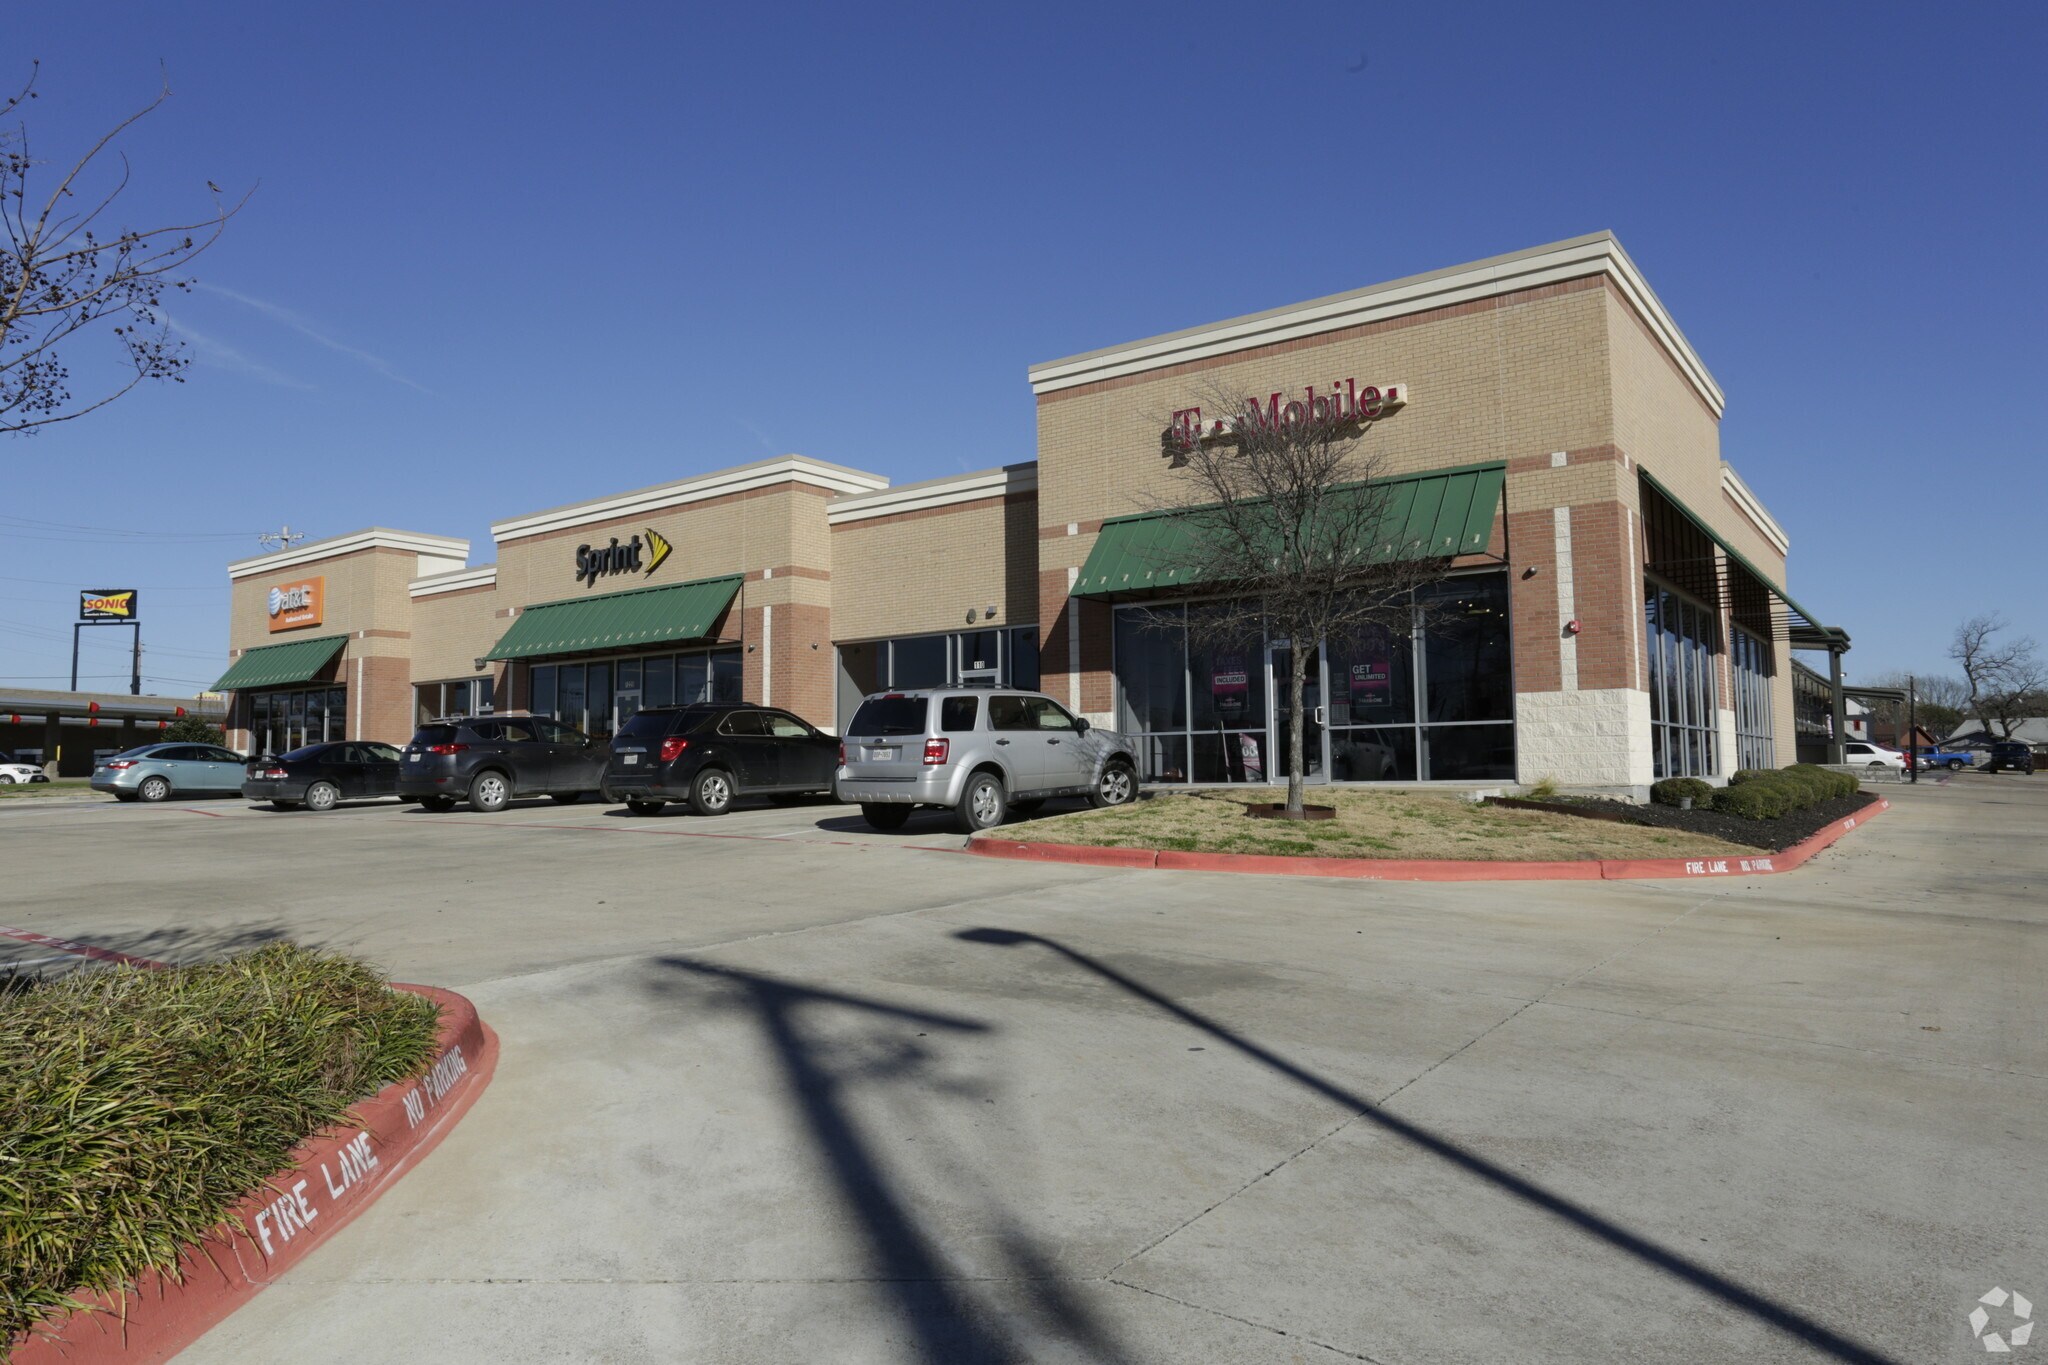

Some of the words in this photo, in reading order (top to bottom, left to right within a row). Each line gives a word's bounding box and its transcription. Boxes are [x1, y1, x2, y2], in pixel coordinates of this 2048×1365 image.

[576, 535, 642, 587] Sprint
[86, 598, 128, 609] SONIC
[1352, 664, 1371, 674] GET
[1355, 673, 1386, 681] UNLIMITED
[1686, 861, 1705, 874] FIRE
[1708, 861, 1729, 873] LANE
[1740, 860, 1751, 872] NO
[255, 1179, 318, 1256] FIRE
[321, 1131, 378, 1200] LANE
[402, 1087, 425, 1129] NO
[422, 1044, 467, 1108] PARKING
